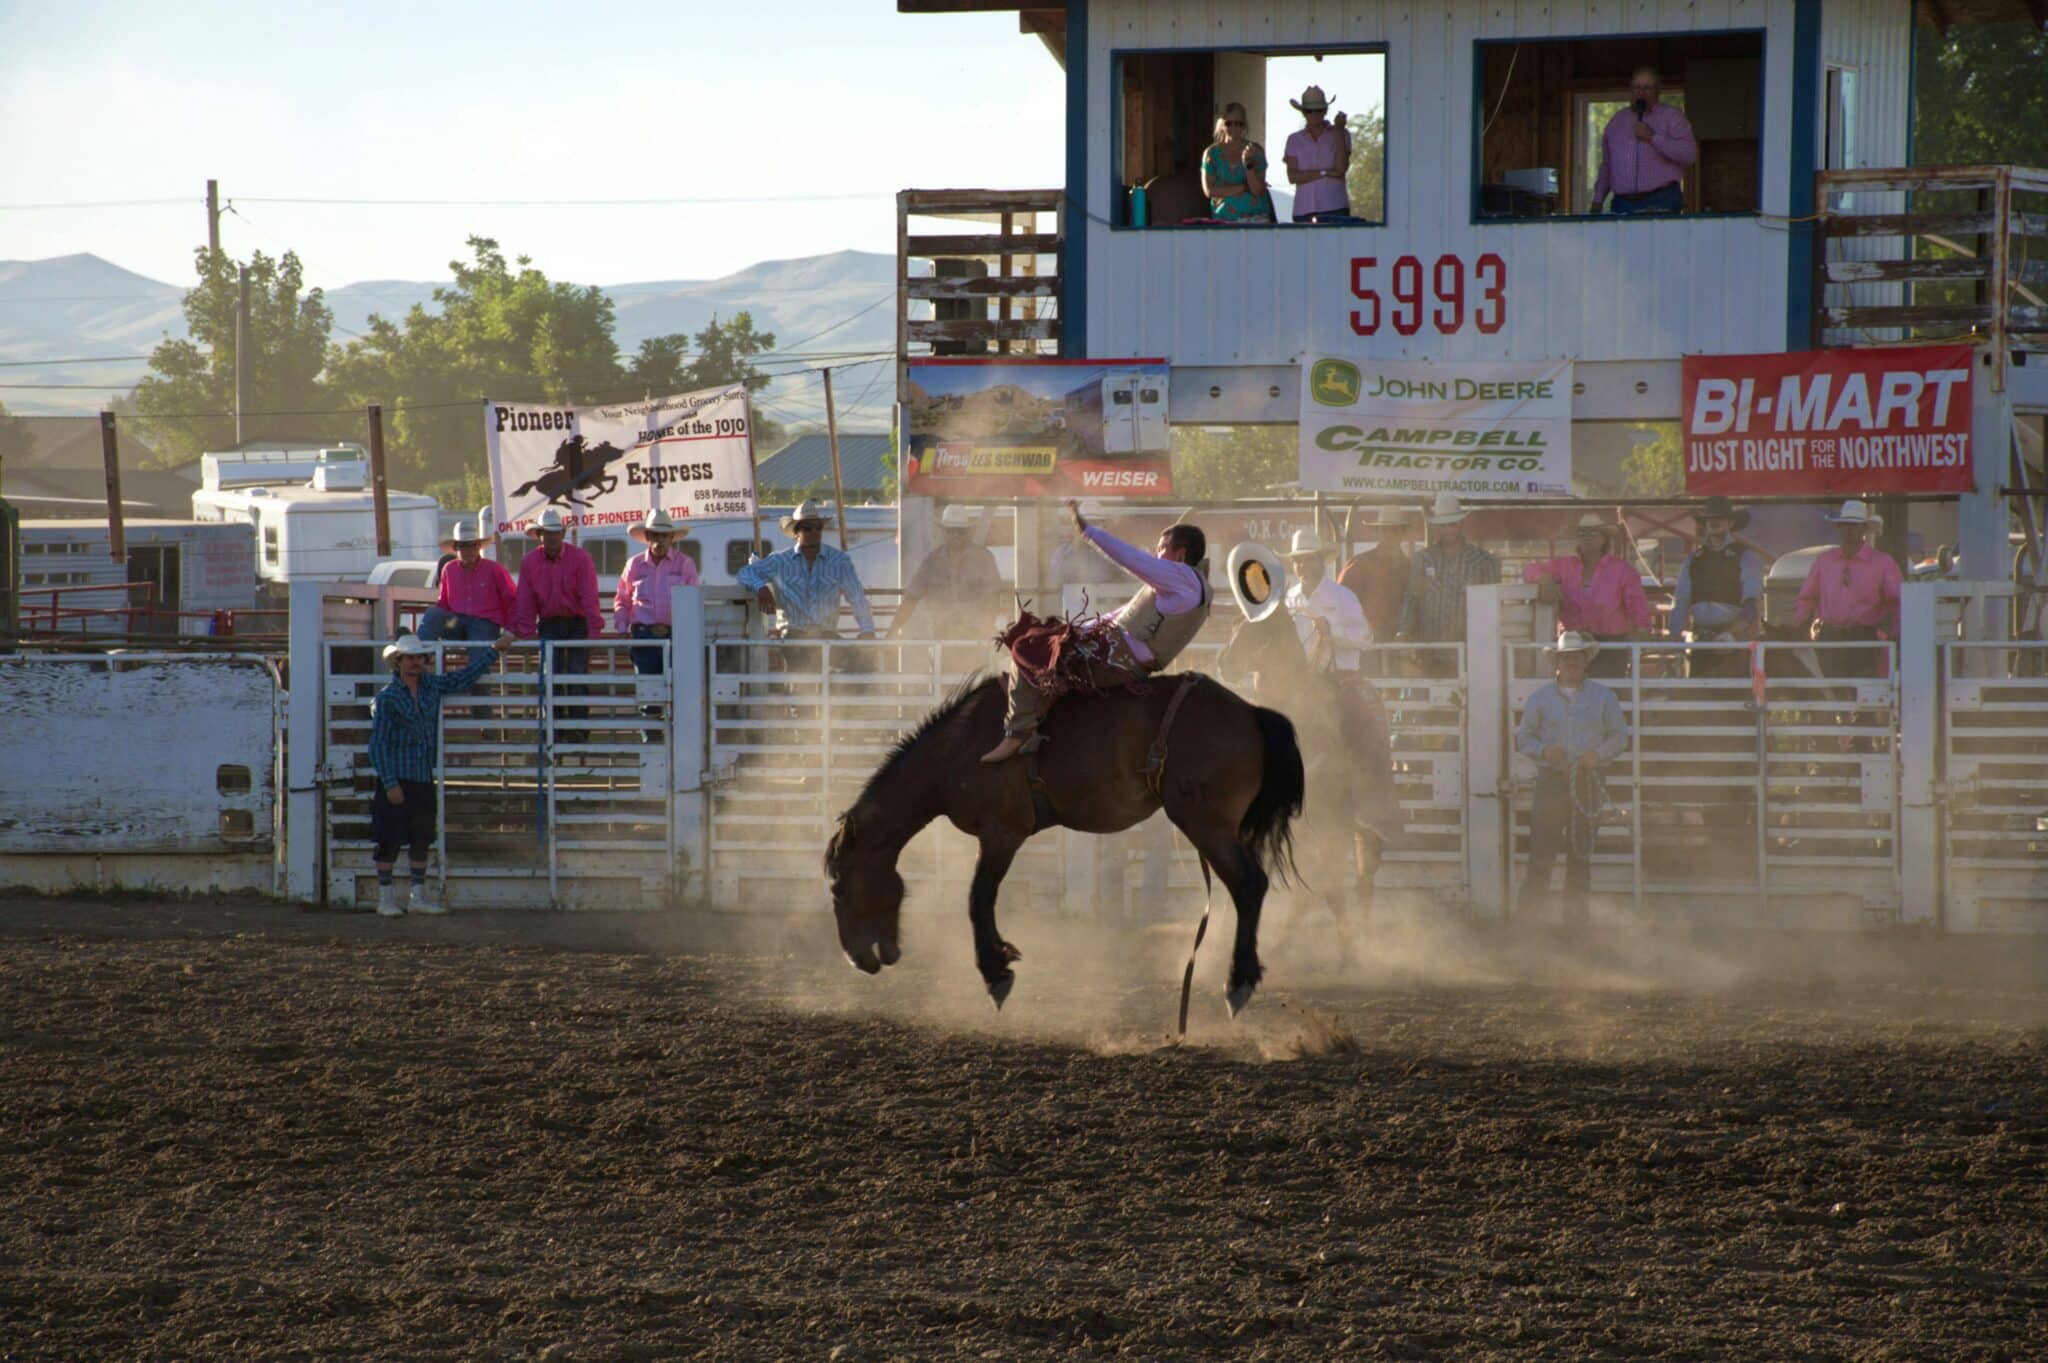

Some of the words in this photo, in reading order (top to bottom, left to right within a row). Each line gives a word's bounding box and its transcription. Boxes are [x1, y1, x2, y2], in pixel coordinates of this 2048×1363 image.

[1350, 253, 1506, 336] 5993
[723, 390, 745, 401] Store
[1368, 375, 1447, 400] JOHN
[1455, 378, 1554, 401] DEERE
[1691, 369, 1969, 435] BI-MART
[495, 406, 574, 432] Pioneer
[638, 426, 675, 444] HOME
[677, 421, 690, 435] of
[693, 420, 712, 434] the
[715, 418, 745, 436] JOJO
[1315, 425, 1548, 451] CAMPBELL
[1810, 439, 1836, 453] FOR
[1840, 433, 1969, 469] NORTHWEST
[1355, 447, 1490, 471] TRACTOR
[1497, 457, 1545, 472] CO.
[1689, 439, 1740, 473] JUST
[1744, 438, 1807, 471] RIGHT
[1810, 454, 1835, 469] THE
[626, 462, 713, 489] Express
[1082, 471, 1159, 487] WEISER
[1342, 476, 1520, 494] WWW.CAMPBELLTRACTOR.COM
[694, 489, 711, 500] 698
[712, 488, 741, 499] Pioneer
[742, 487, 752, 498] Rd
[581, 514, 595, 526] OF
[598, 510, 643, 525] PIONEER
[671, 507, 689, 519] 7TH
[704, 502, 746, 513] 414-5656
